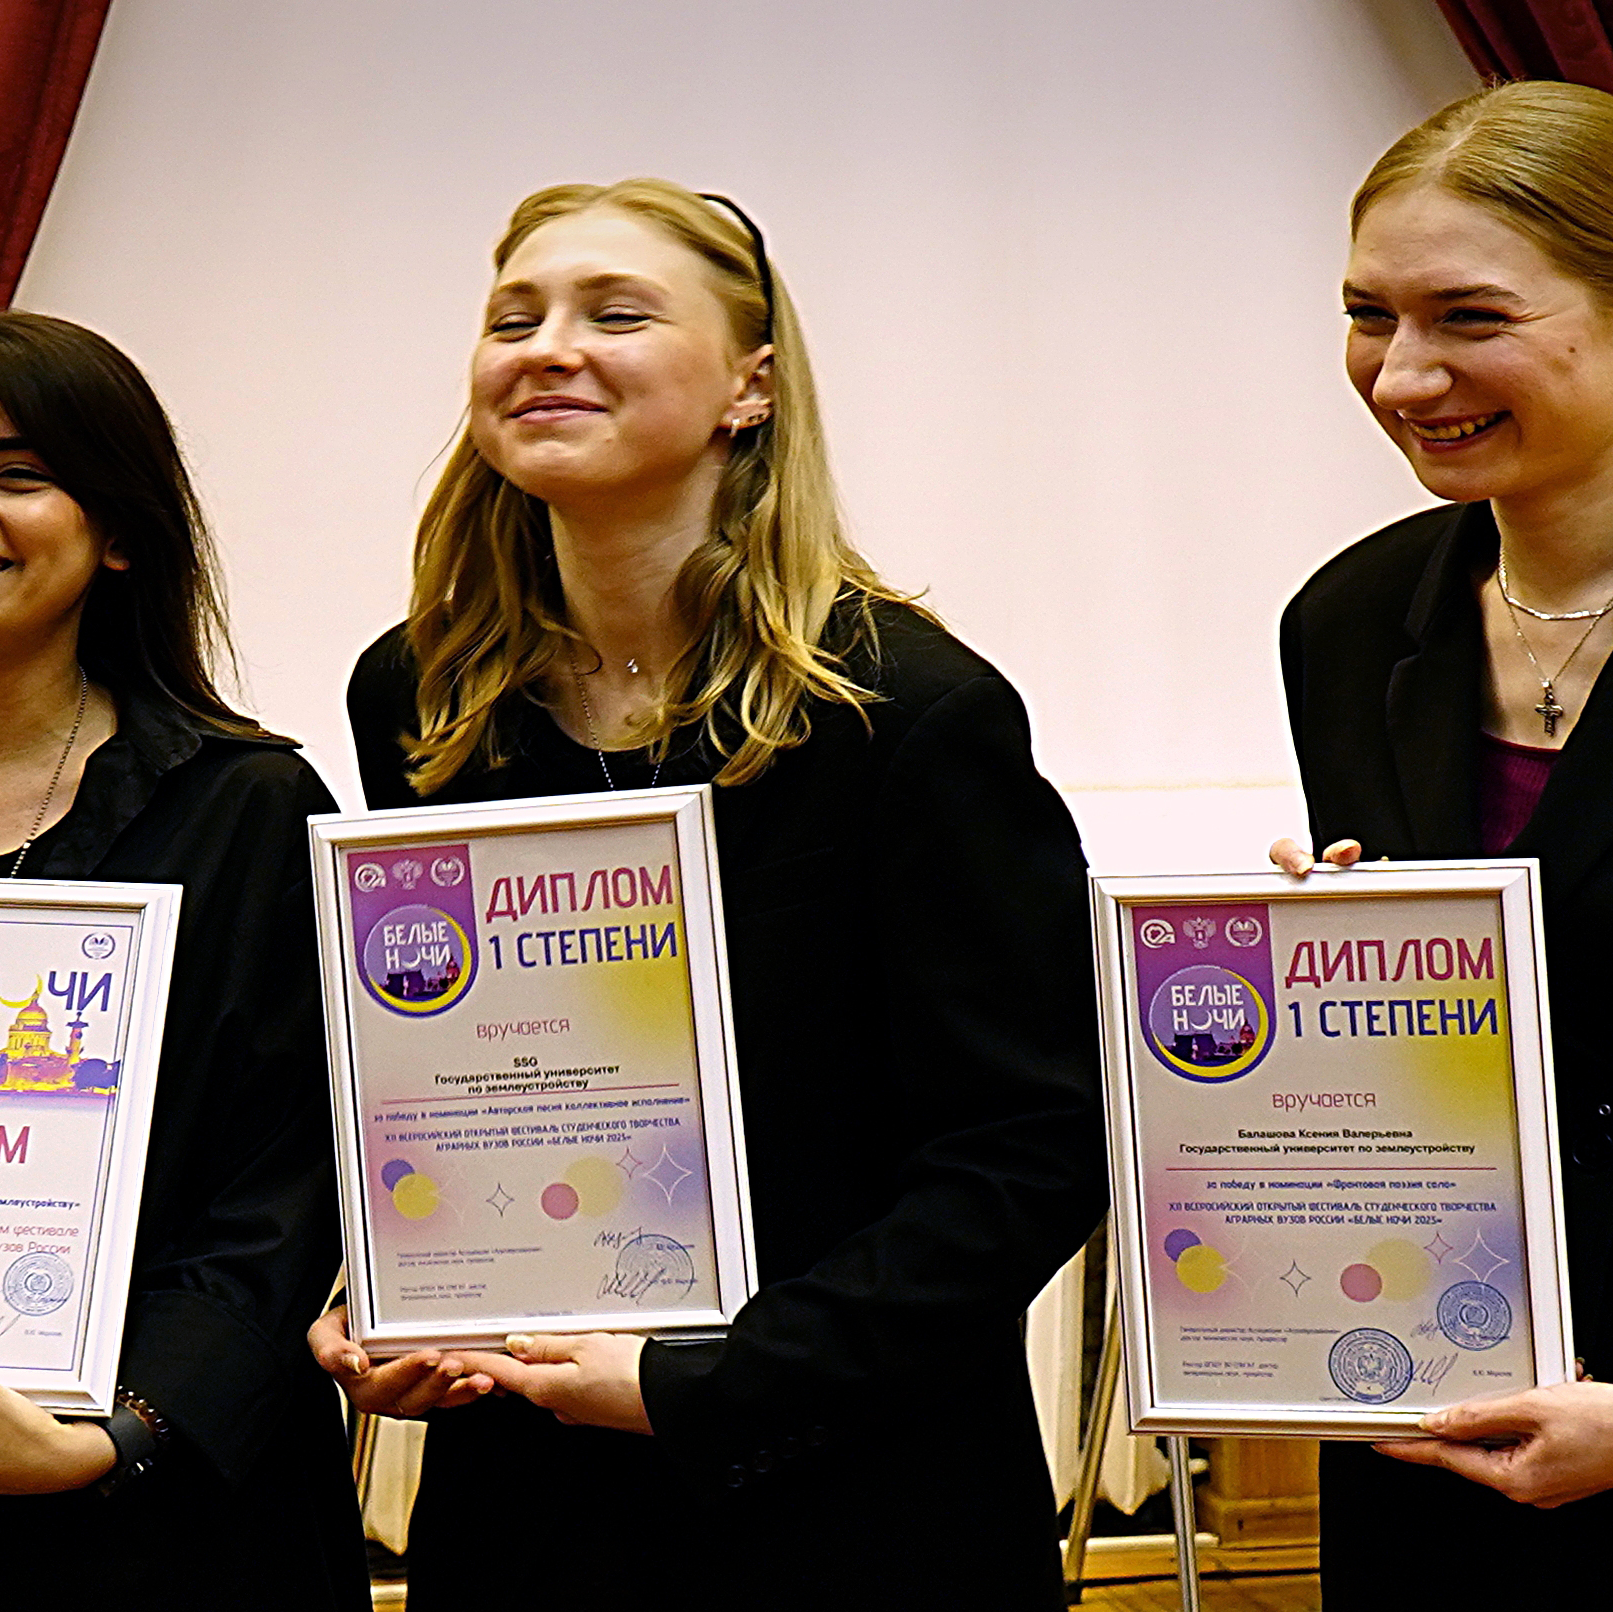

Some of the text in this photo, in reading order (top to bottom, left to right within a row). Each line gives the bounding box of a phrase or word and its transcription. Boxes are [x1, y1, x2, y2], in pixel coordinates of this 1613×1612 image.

[485, 864, 674, 924] ДИПЛОМ
[383, 921, 448, 946] БЕЛЫЕ
[488, 922, 678, 970] 1 СТЕПЕНИ
[1284, 937, 1495, 990] ДИПЛОМ
[1171, 984, 1244, 1007] БЕЛЫЕ
[1287, 998, 1500, 1038] 1 СТЕПЕНИ
[476, 1017, 570, 1042] вручается
[434, 1065, 620, 1085] Государственный университет
[468, 1077, 588, 1094] по землеустройству
[1272, 1092, 1376, 1112] вручается
[1238, 1128, 1413, 1139] Балашова Ксения Валерьевна
[1179, 1143, 1475, 1155] Государственный университет по землеустройству
[1441, 1202, 1497, 1212] ТВОРЧЕСТВА
[13, 1224, 80, 1237] фестивале
[28, 1241, 71, 1254] России
